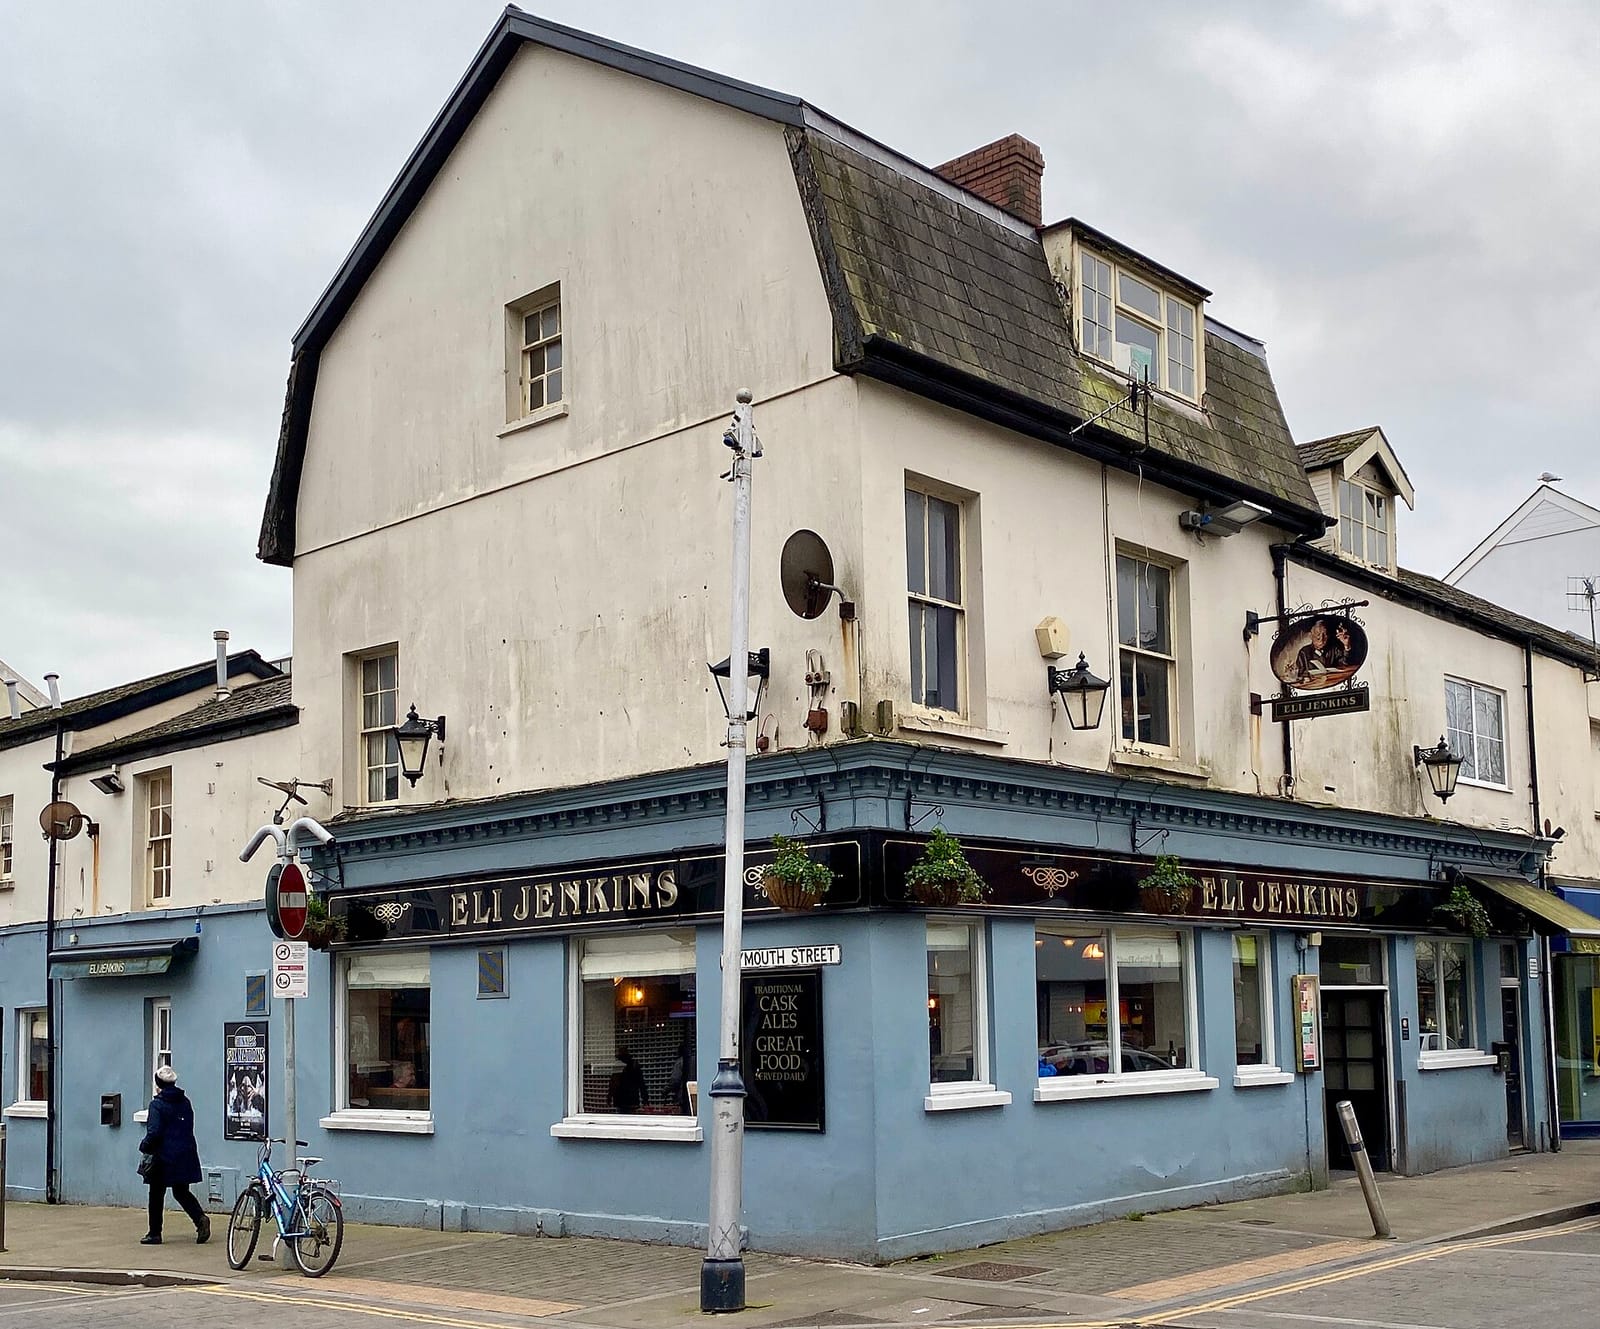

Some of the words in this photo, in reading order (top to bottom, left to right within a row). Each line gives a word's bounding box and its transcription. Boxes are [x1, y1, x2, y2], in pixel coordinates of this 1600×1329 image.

[1284, 703, 1302, 713] ELI
[1306, 696, 1356, 711] JENKINS
[451, 888, 503, 926] ELI
[513, 869, 678, 921] JENKINS
[1201, 877, 1245, 911] ELI
[1252, 881, 1358, 918] JENKINS
[791, 947, 834, 964] STREET
[754, 984, 804, 995] TRADITIONAL
[759, 995, 798, 1012] CASK
[761, 1012, 798, 1029] ALES
[756, 1035, 804, 1052] GREAT
[760, 1054, 801, 1070] FOOD
[783, 1071, 806, 1081] DAILY
